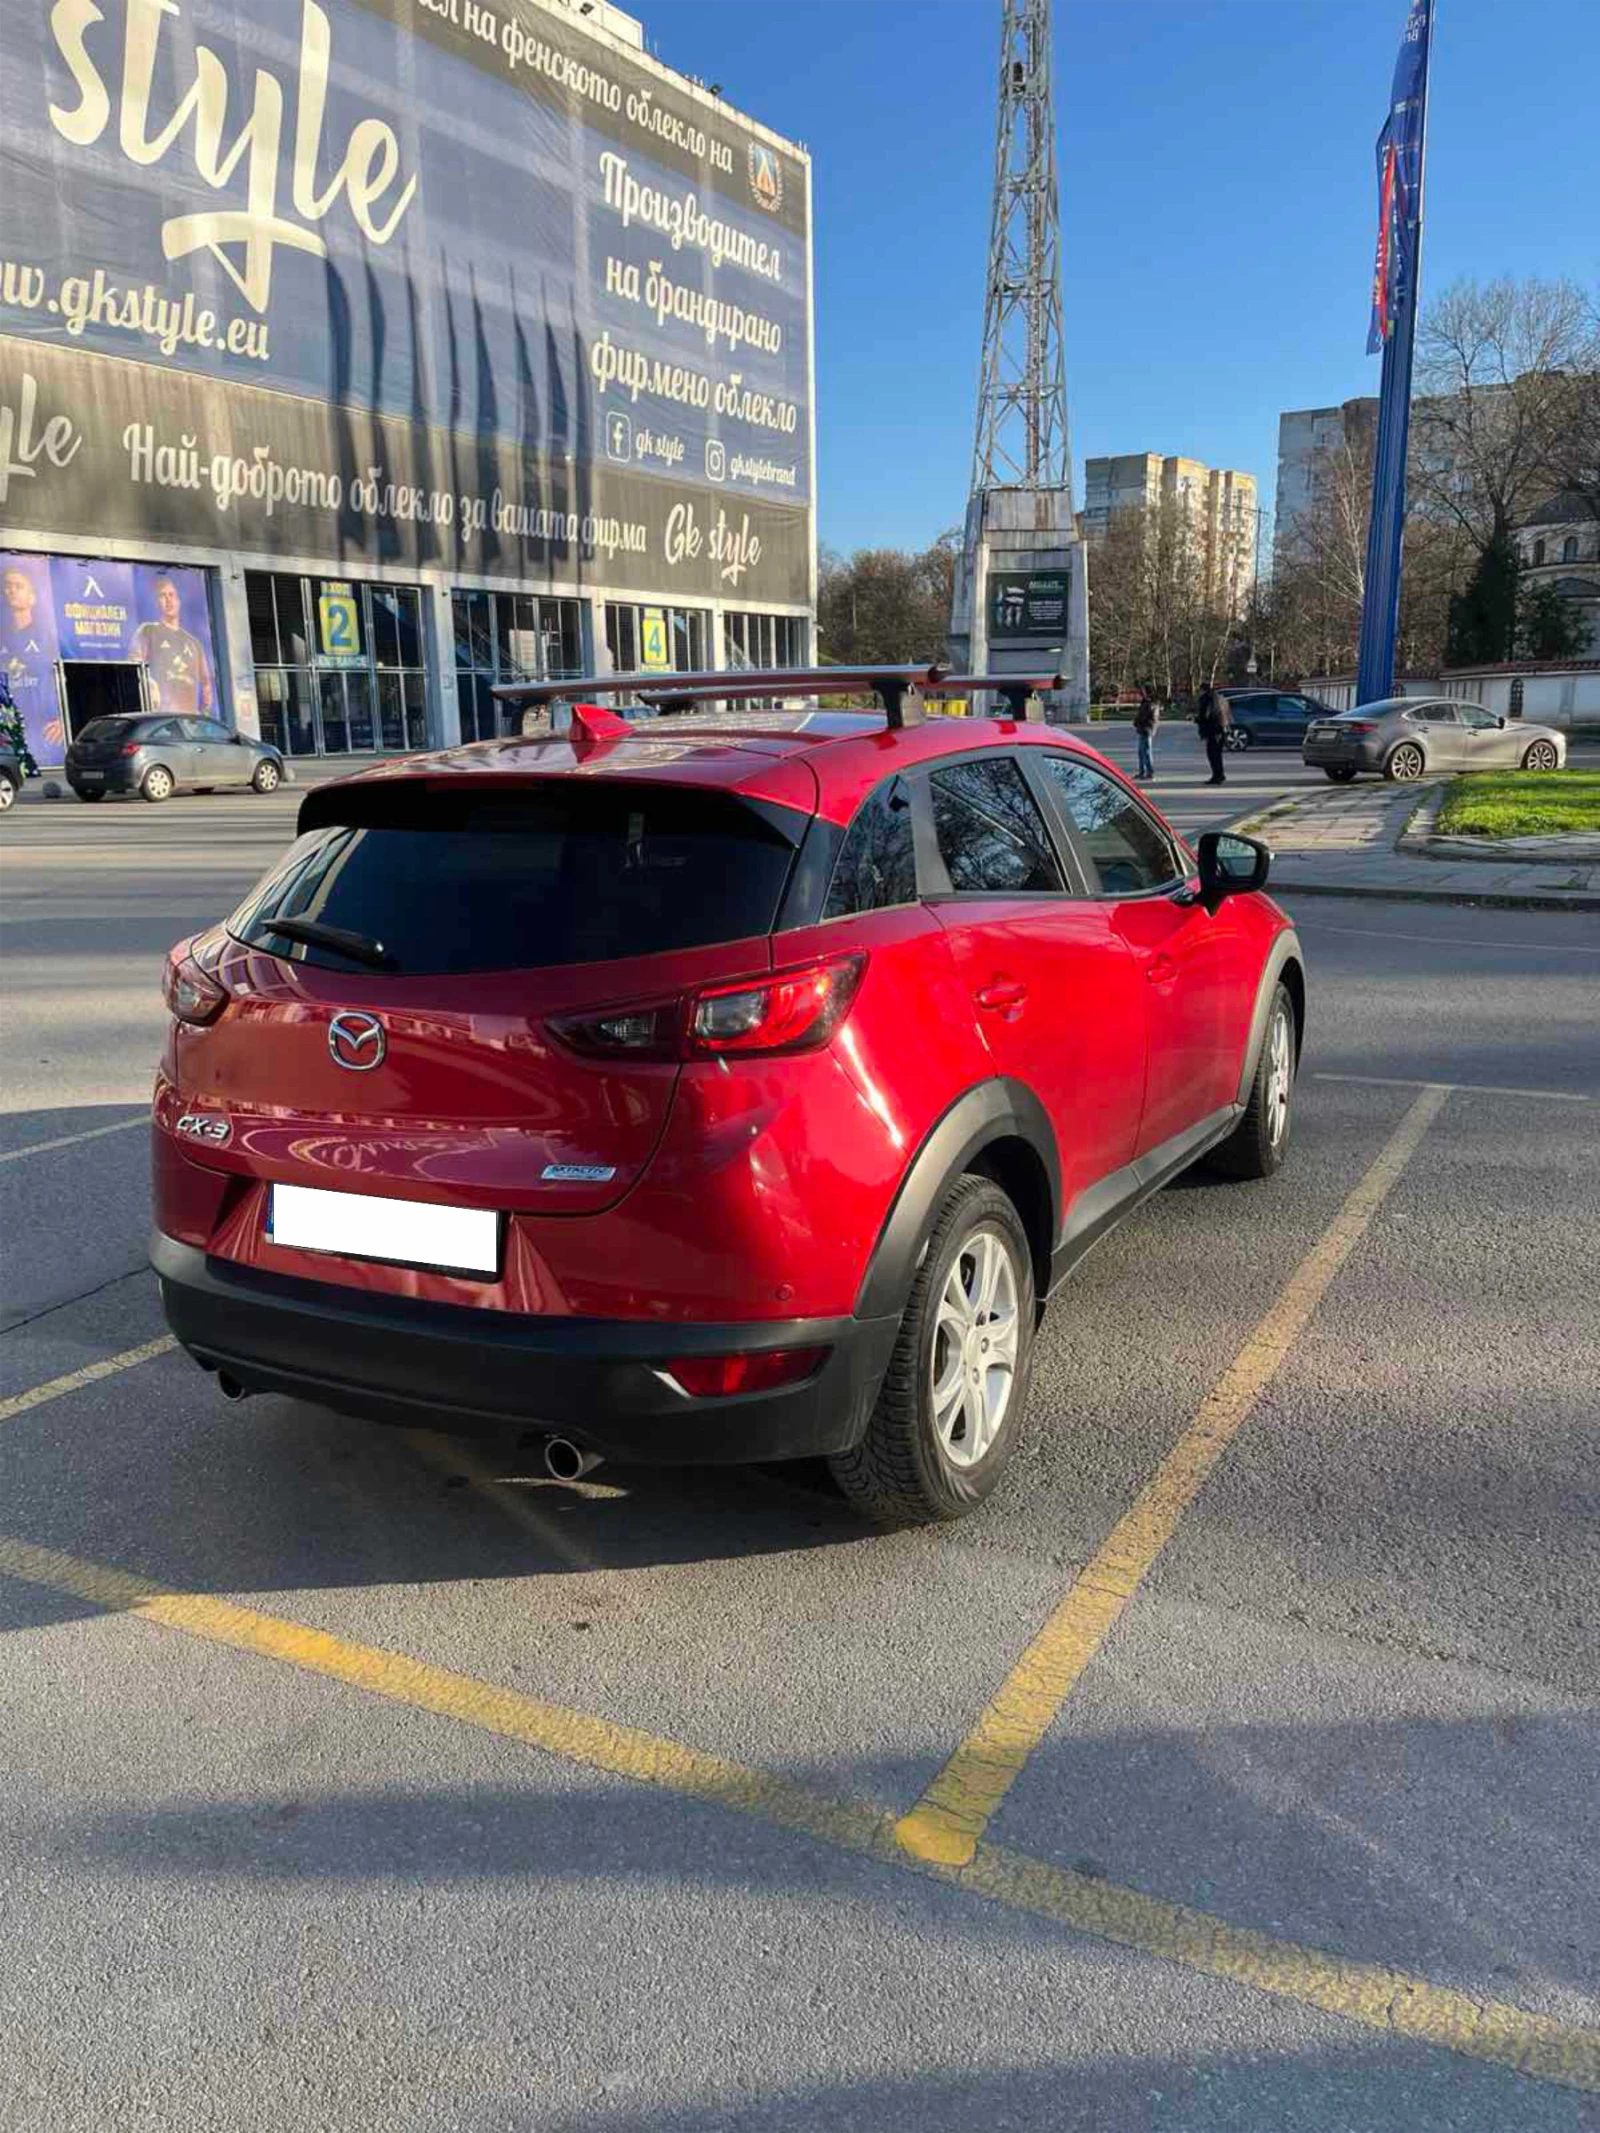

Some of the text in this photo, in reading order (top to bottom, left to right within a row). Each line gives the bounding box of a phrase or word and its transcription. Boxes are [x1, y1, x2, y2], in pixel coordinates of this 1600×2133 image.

[464, 0, 497, 45] на
[502, 18, 621, 113] фенското
[626, 90, 706, 158] облекло
[710, 135, 733, 174] на
[48, 0, 417, 314] style
[600, 151, 782, 281] Производител
[0, 260, 270, 360] w.gkstyle.eu
[607, 255, 782, 354] на брандирано
[592, 331, 797, 433] фирмено облекло
[123, 423, 647, 560] Най-доброто облекло за вашата фирма
[636, 429, 652, 459] gk
[655, 434, 685, 467] style
[730, 454, 797, 486] gkstylebrand
[664, 503, 762, 587] Gk style
[328, 605, 353, 647] 2
[648, 625, 662, 657] 4
[176, 1116, 229, 1139] CX-3
